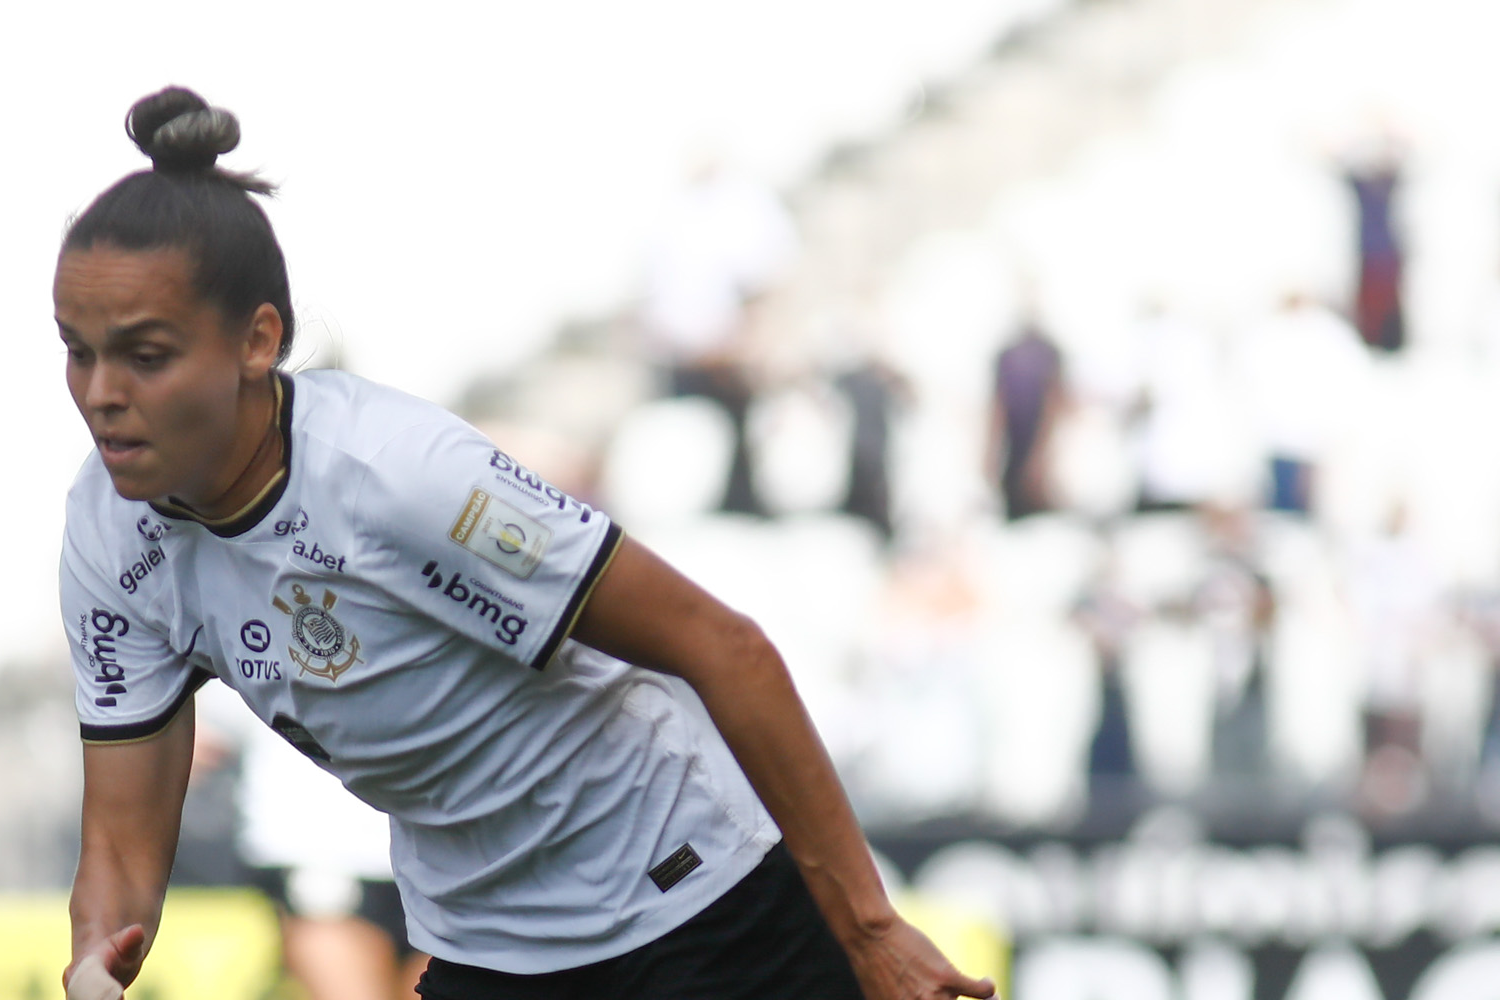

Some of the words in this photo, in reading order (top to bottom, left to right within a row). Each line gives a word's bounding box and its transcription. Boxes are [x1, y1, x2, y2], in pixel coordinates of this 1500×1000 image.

[489, 449, 567, 510] bmg
[495, 473, 549, 506] CORINTHIANS
[443, 572, 529, 645] bmg
[469, 577, 525, 611] CORINTHIANS
[91, 607, 130, 682] bmg
